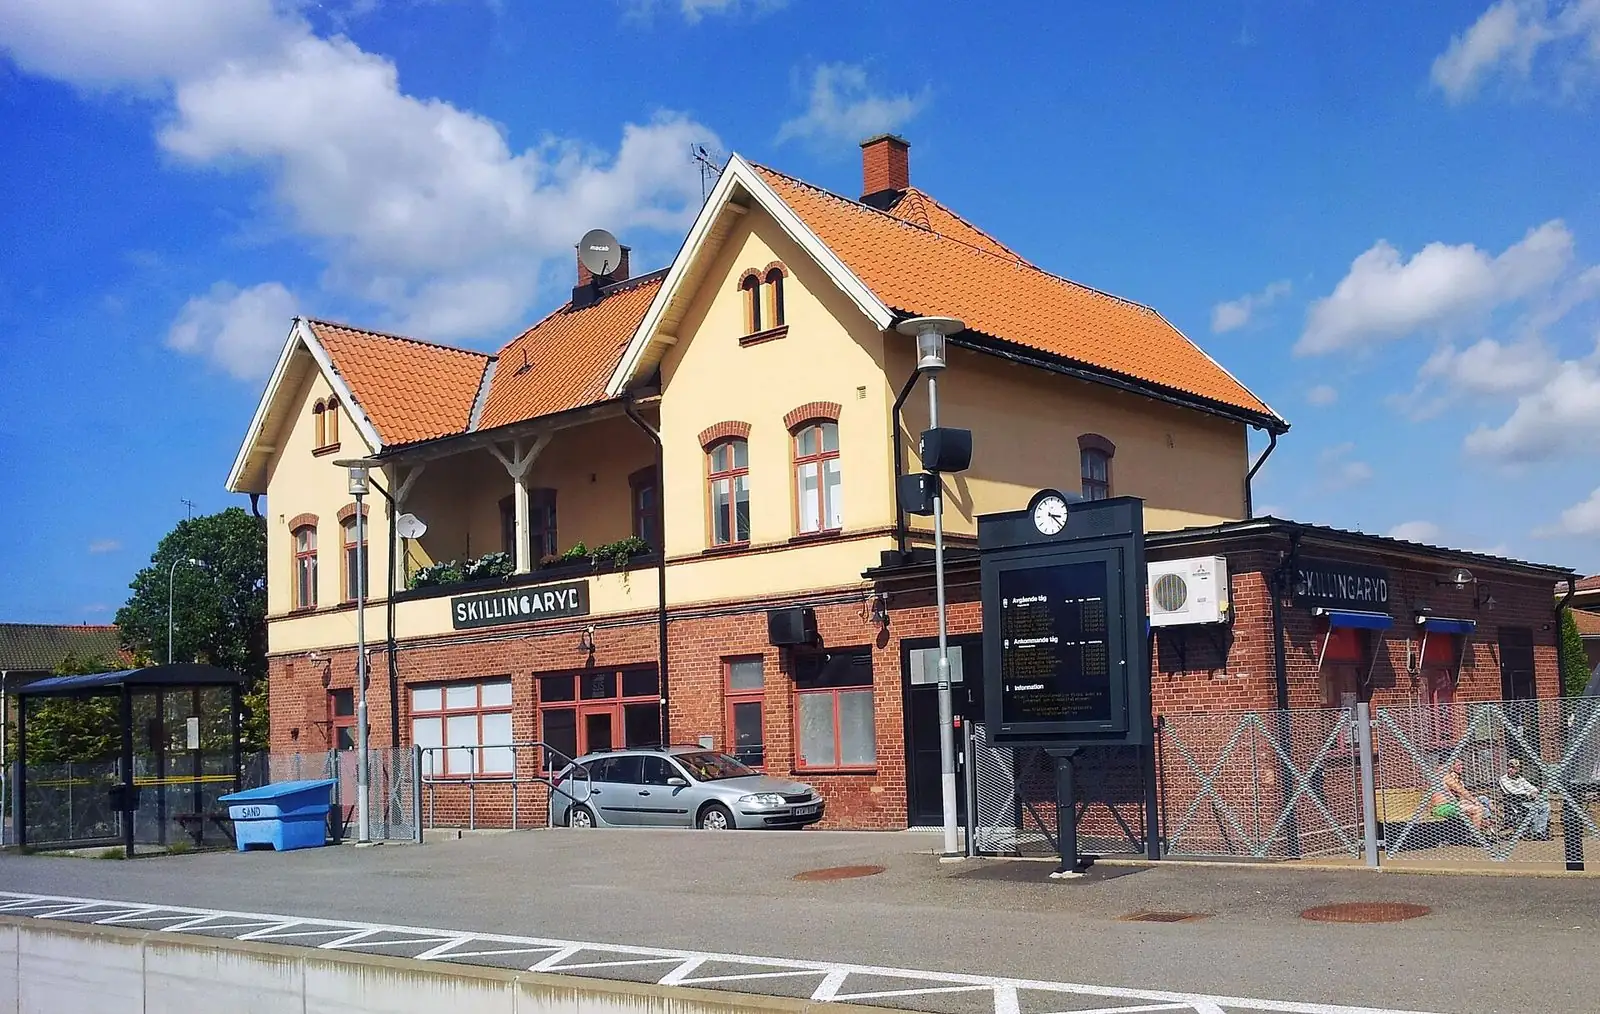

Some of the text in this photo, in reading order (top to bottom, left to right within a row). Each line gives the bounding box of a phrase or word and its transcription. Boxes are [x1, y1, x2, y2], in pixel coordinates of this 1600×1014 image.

[1298, 570, 1388, 602] SKILLINGARYD
[457, 588, 578, 622] SKILLINGARYD
[1014, 683, 1044, 691] Information
[242, 806, 261, 818] SAND
